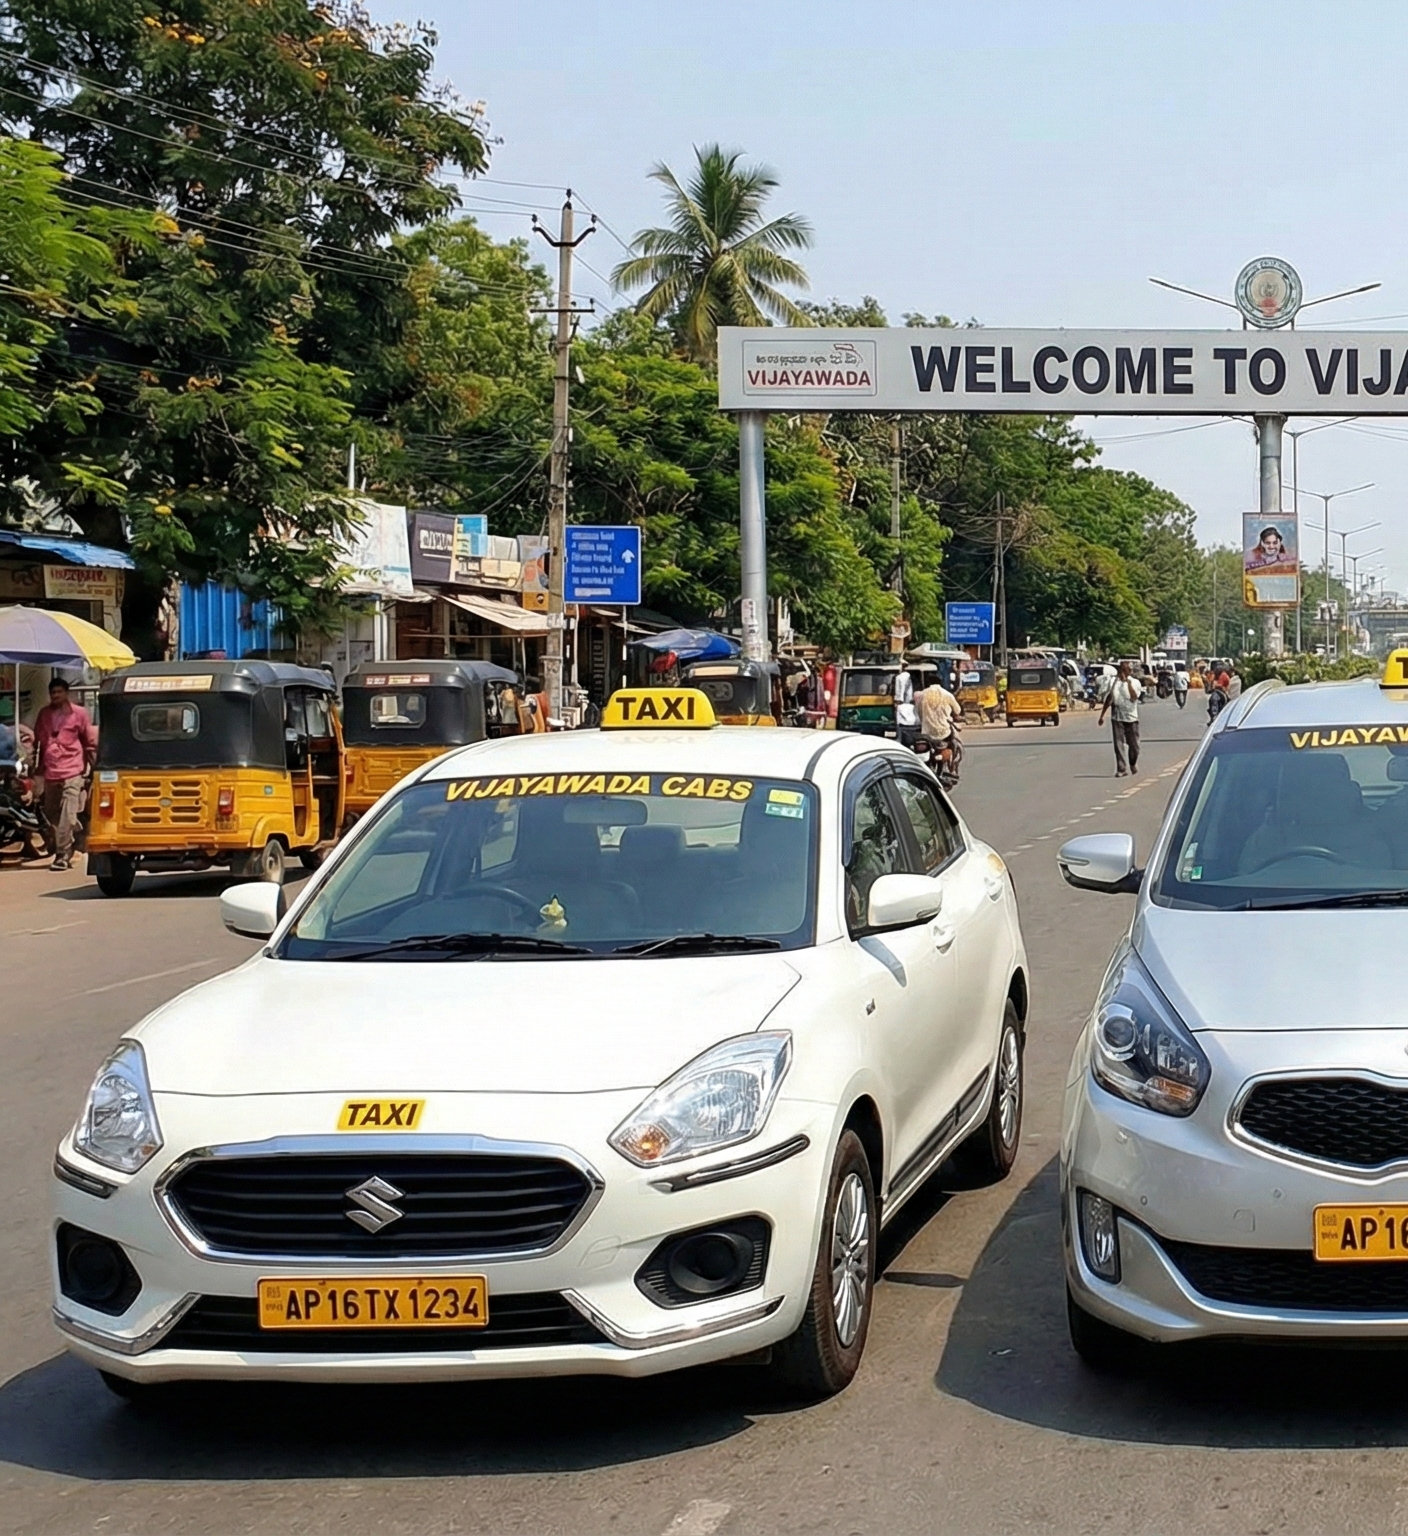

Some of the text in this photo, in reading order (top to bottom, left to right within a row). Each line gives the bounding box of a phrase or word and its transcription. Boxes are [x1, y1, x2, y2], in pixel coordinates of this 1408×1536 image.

[747, 369, 871, 386] VIJAYAWADA
[911, 345, 1194, 394] WELCOME
[1213, 347, 1287, 395] TO
[616, 697, 695, 721] TAXI
[445, 774, 754, 802] VIJAYAWADA CABS
[346, 1103, 419, 1127] TAXI
